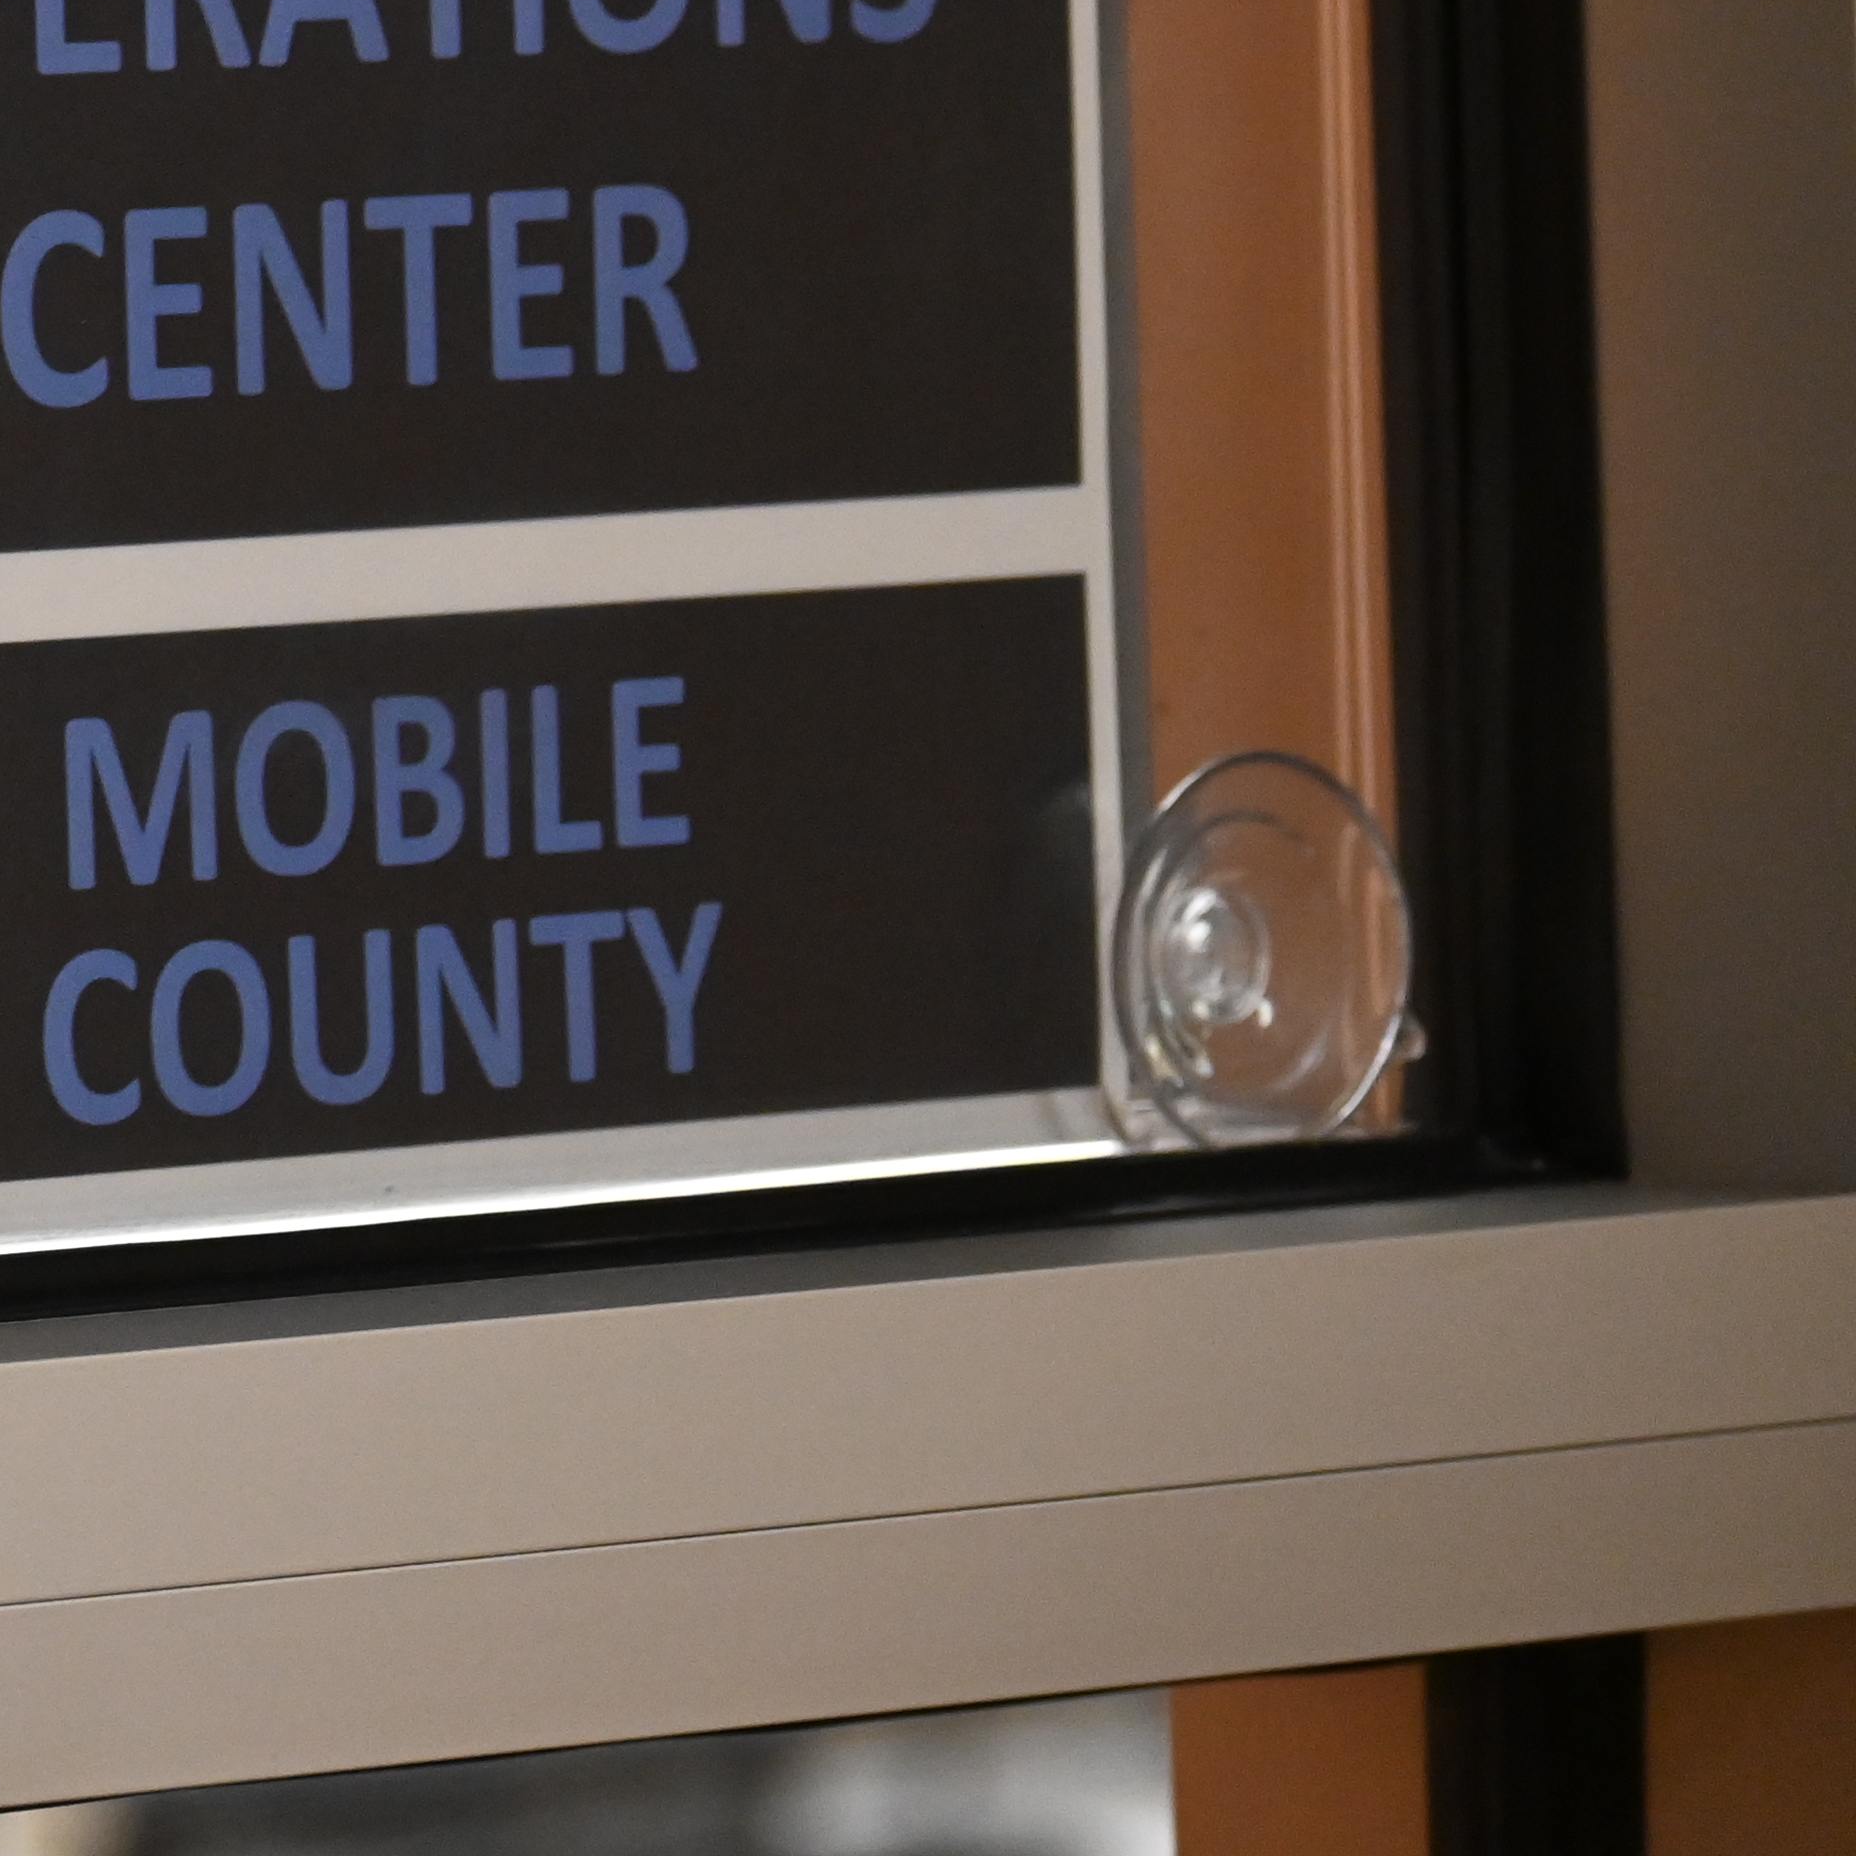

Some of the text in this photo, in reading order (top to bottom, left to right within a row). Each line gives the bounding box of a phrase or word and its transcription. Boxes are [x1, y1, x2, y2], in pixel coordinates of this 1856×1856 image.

[0, 184, 699, 412] CENTER
[65, 675, 691, 891] MOBILE
[43, 902, 722, 1126] COUNTY
